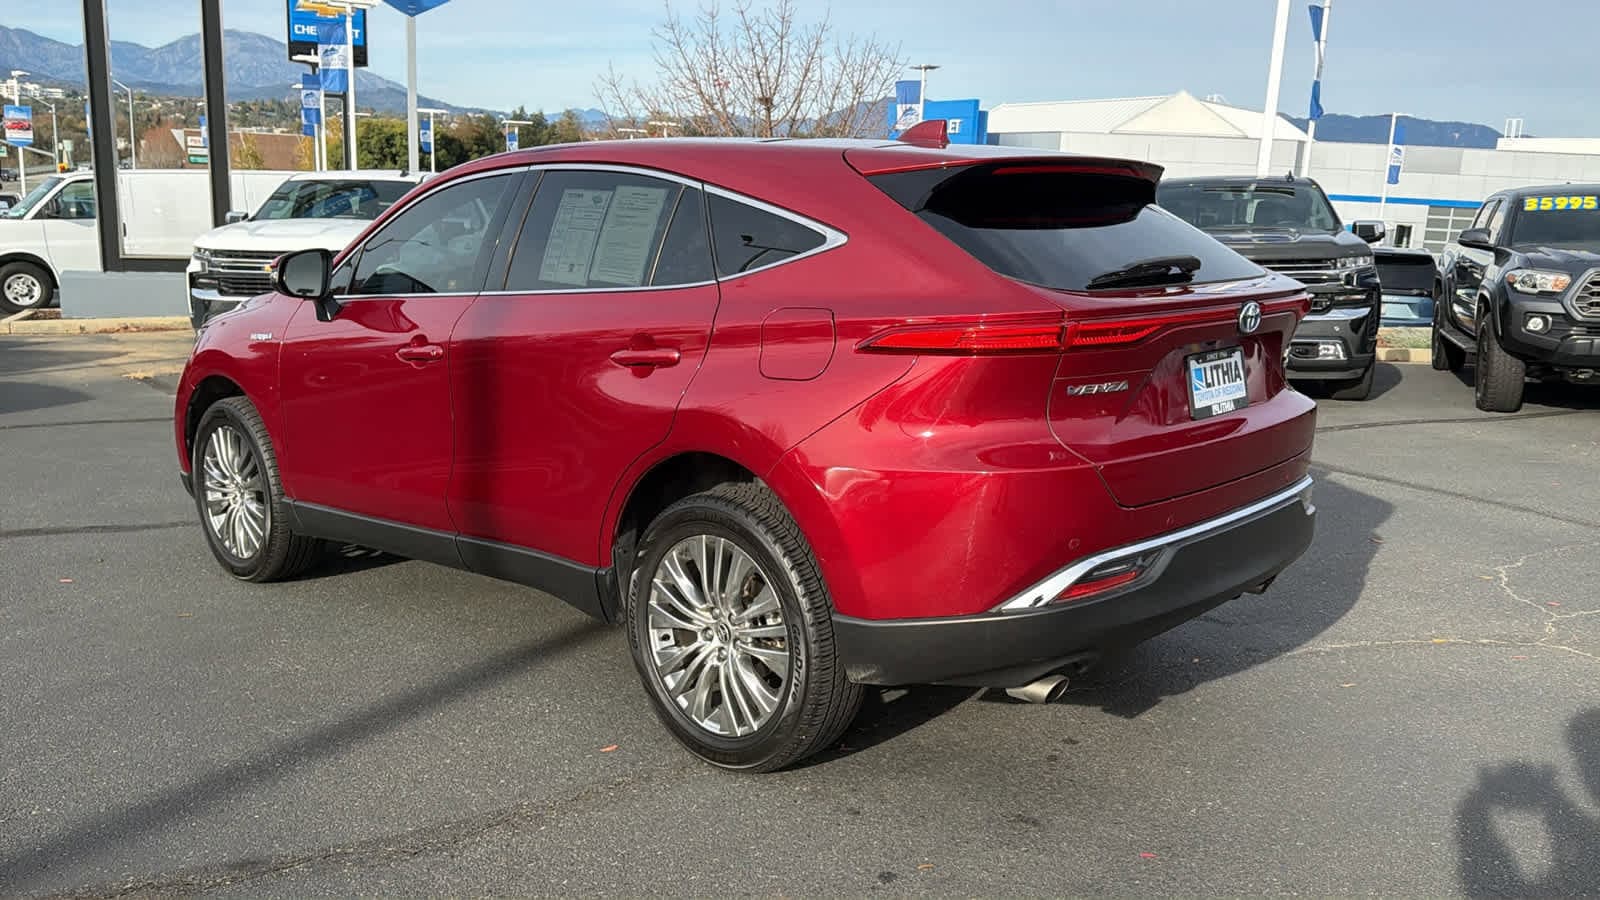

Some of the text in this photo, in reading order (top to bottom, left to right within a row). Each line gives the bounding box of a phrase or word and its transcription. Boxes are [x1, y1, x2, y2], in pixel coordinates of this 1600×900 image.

[1524, 196, 1597, 211] 35995
[1203, 360, 1242, 389] LITHIA
[1067, 380, 1129, 396] VENZA
